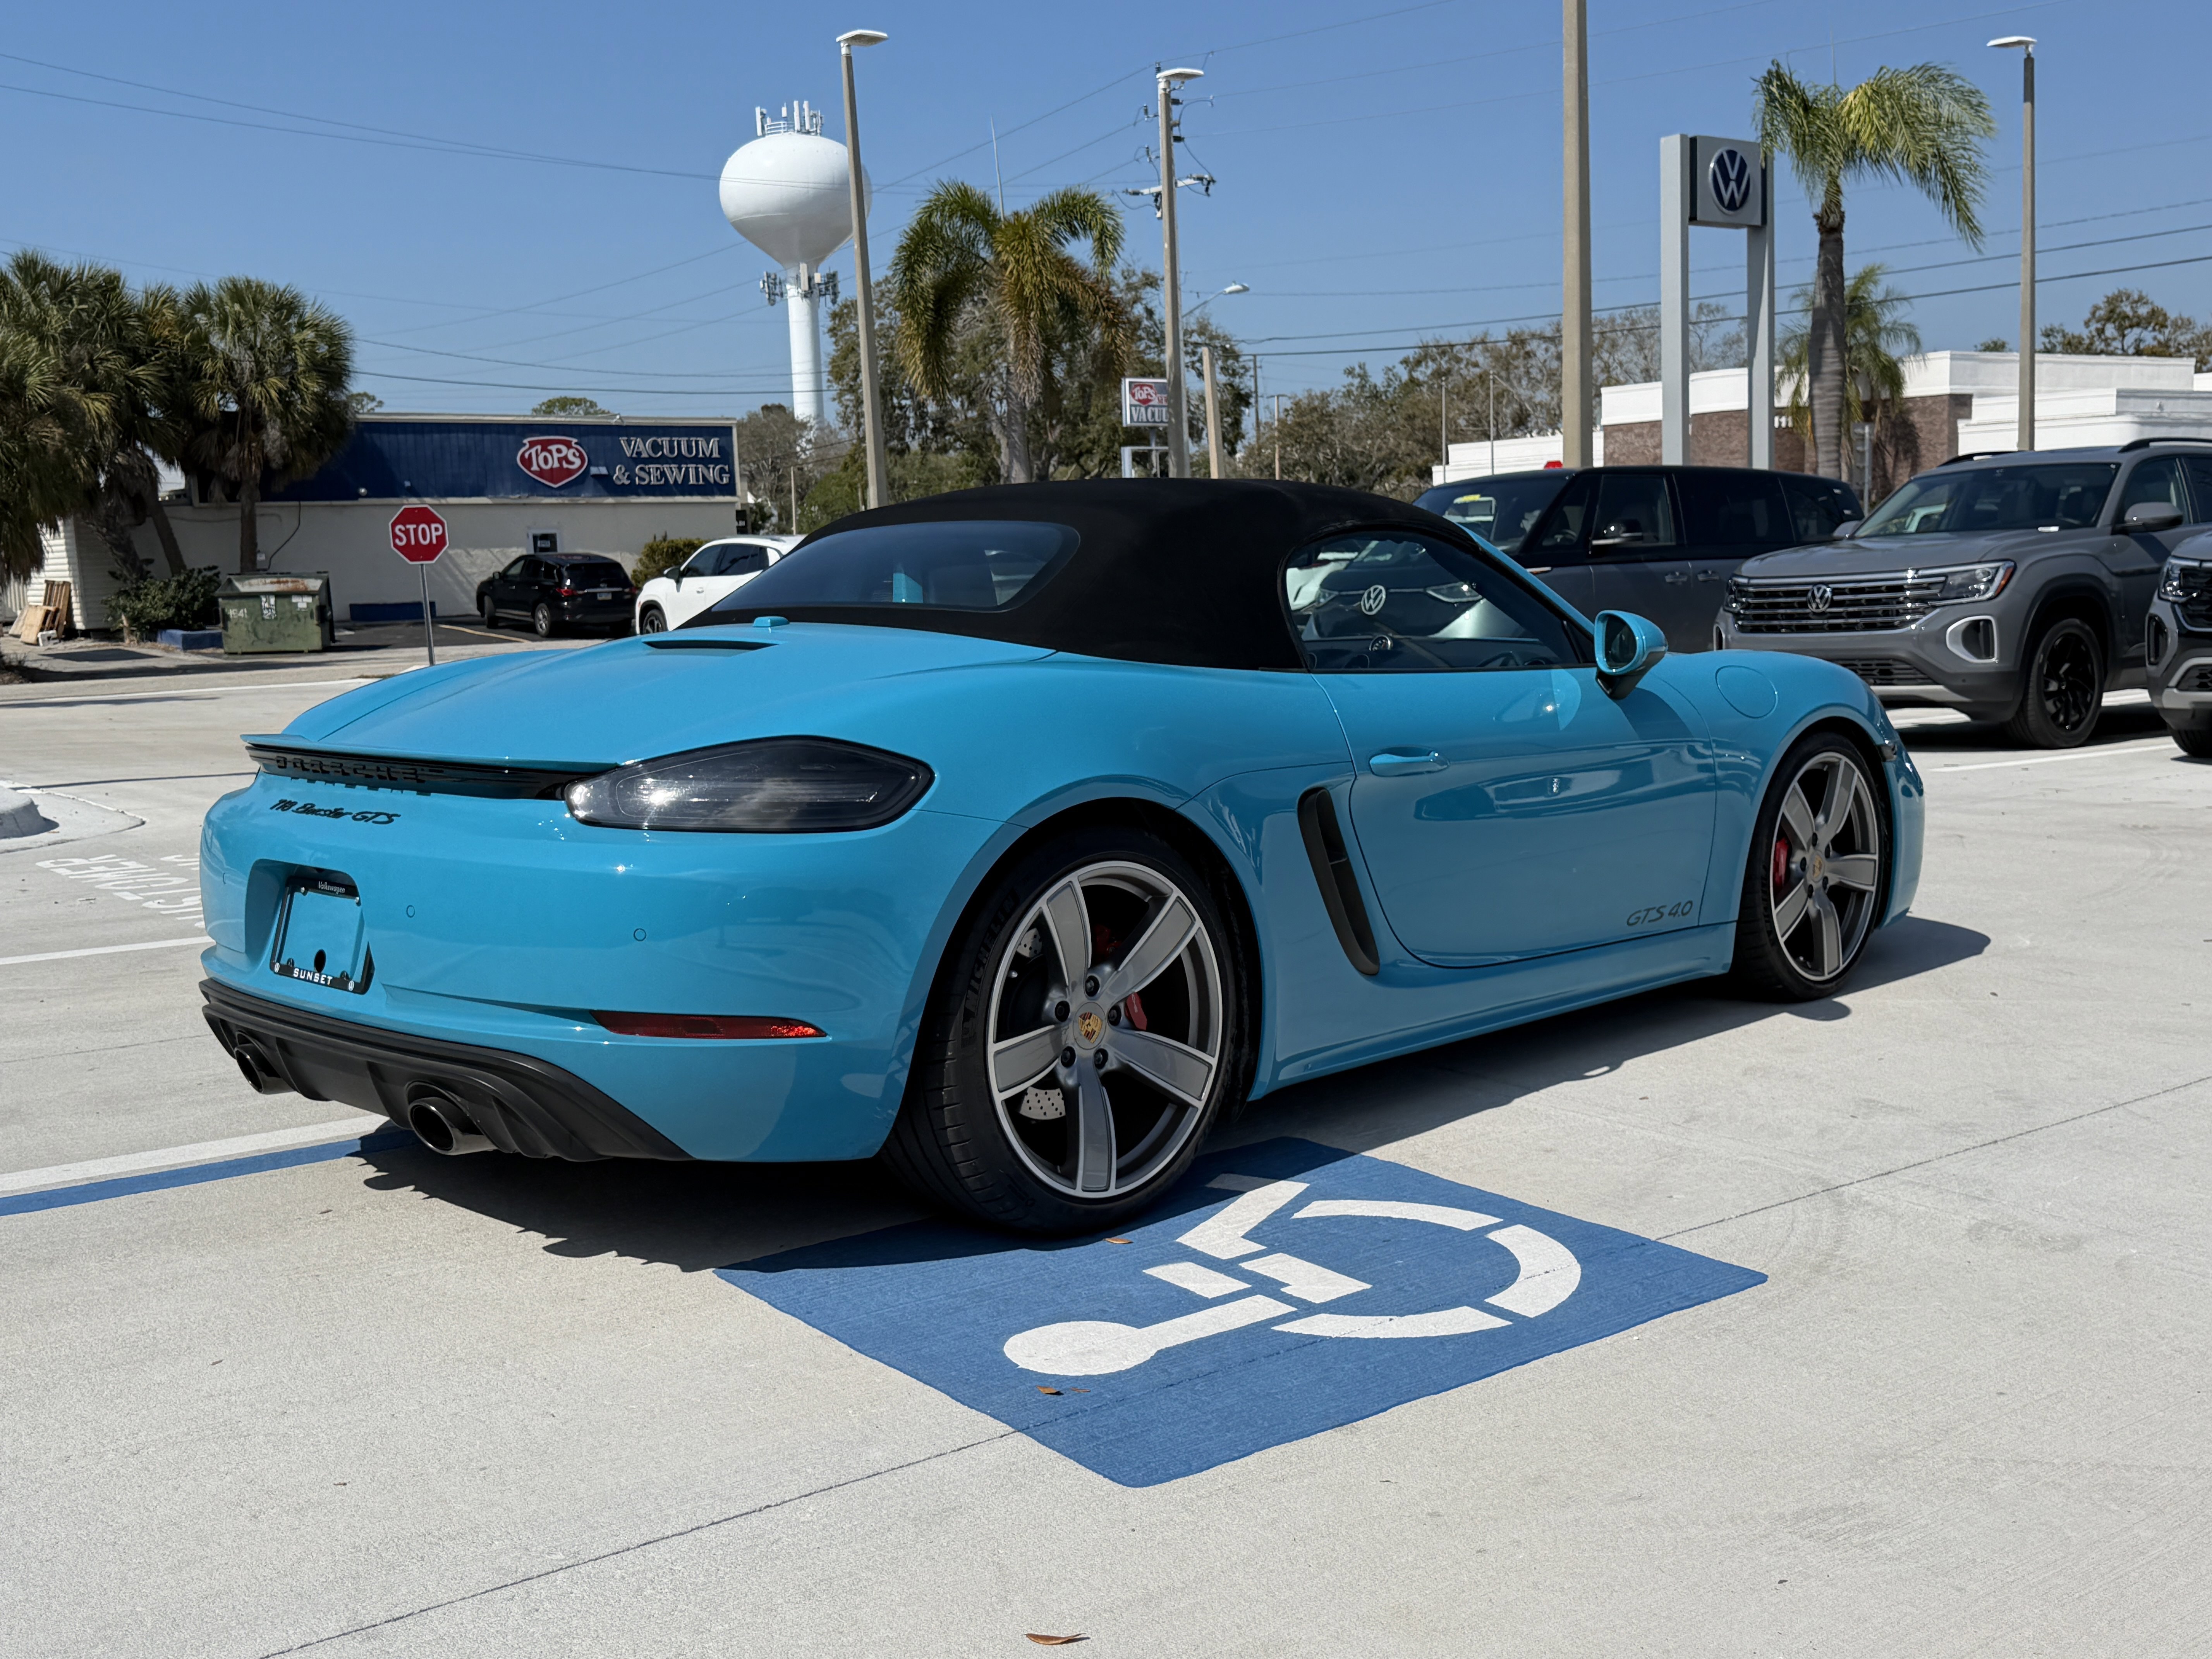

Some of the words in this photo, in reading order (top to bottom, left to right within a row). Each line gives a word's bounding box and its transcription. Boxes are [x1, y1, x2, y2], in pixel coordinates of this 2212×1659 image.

[1131, 407, 1169, 422] VACUU
[619, 437, 721, 458] VACUUM
[613, 465, 630, 485] &
[635, 464, 730, 485] SEWING
[395, 524, 443, 546] STOP
[352, 811, 401, 824] GTS
[1626, 905, 1667, 926] GTS
[1668, 900, 1693, 917] 4.0
[293, 968, 333, 985] SUNSET
